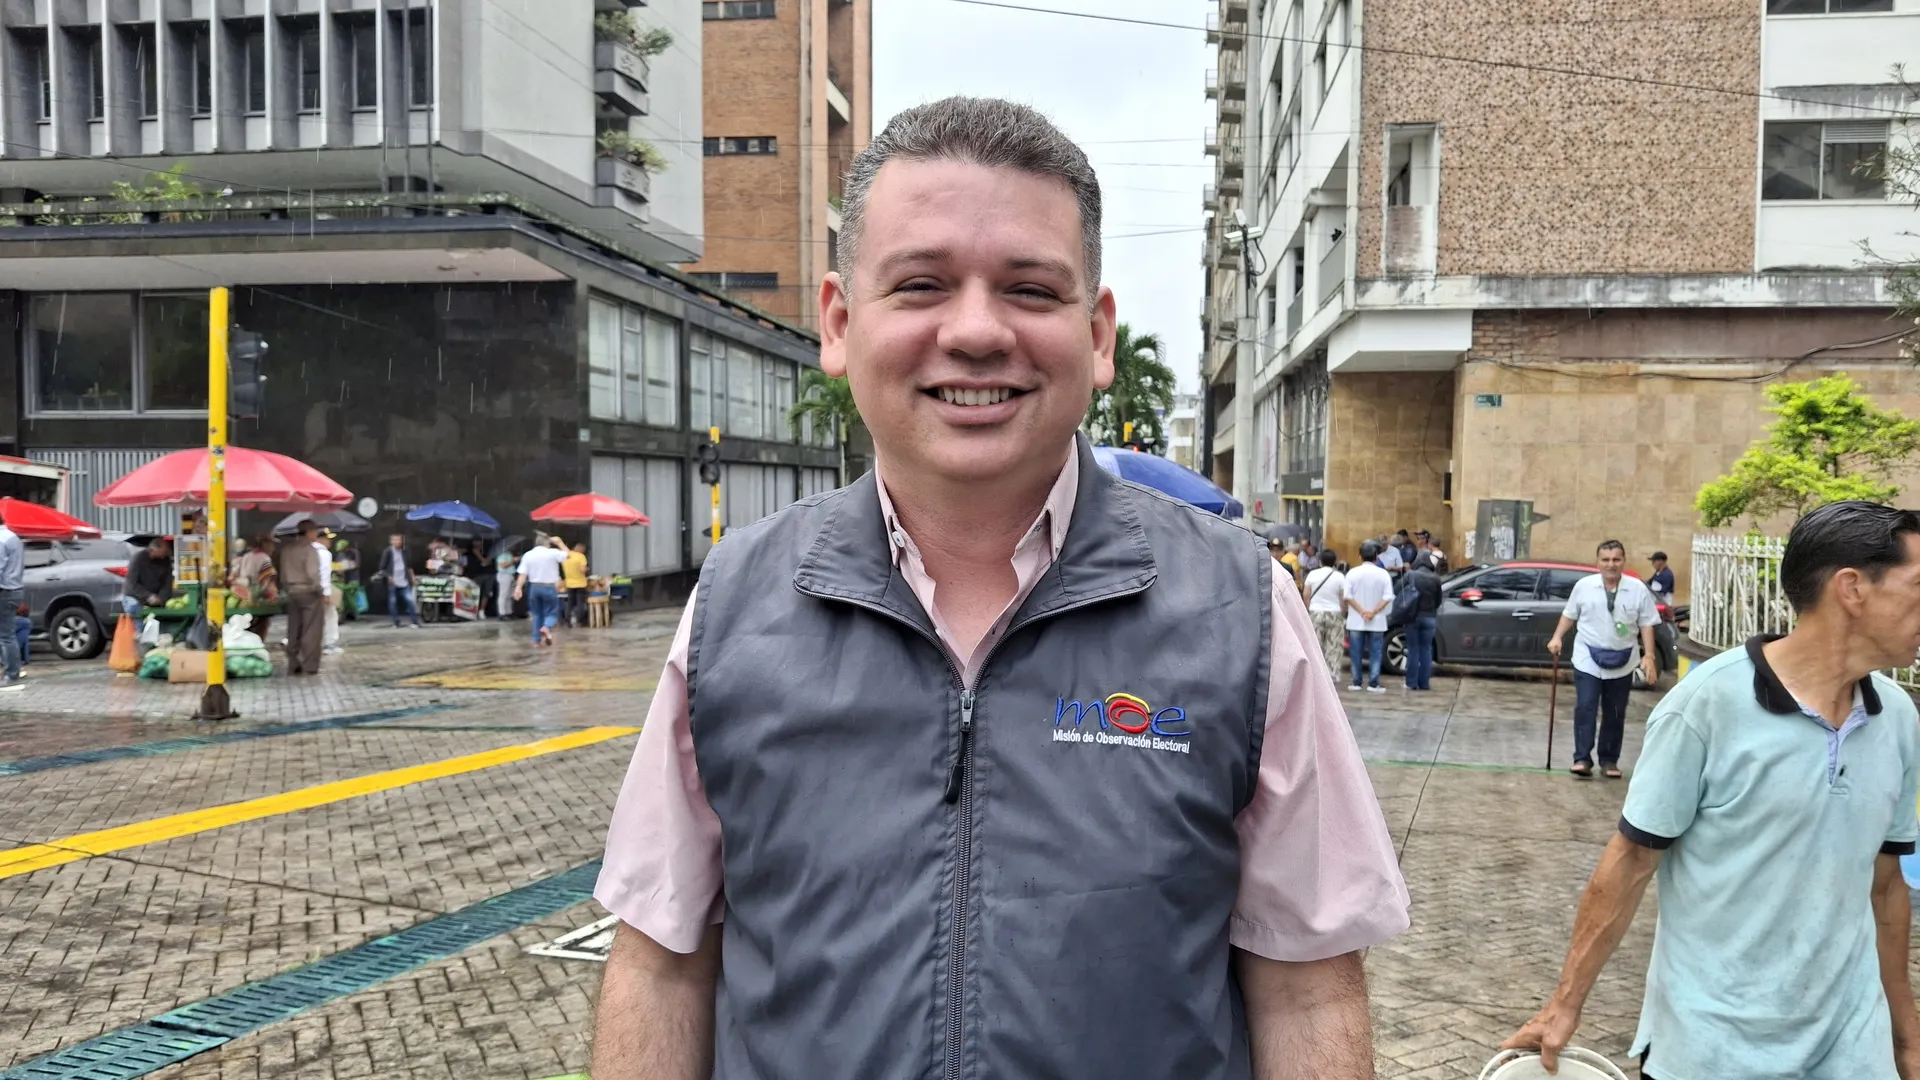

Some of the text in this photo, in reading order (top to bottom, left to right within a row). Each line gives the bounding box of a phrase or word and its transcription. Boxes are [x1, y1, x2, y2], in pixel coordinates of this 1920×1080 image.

[1055, 693, 1191, 736] moe
[1053, 728, 1190, 753] Misión de Observación Electoral
